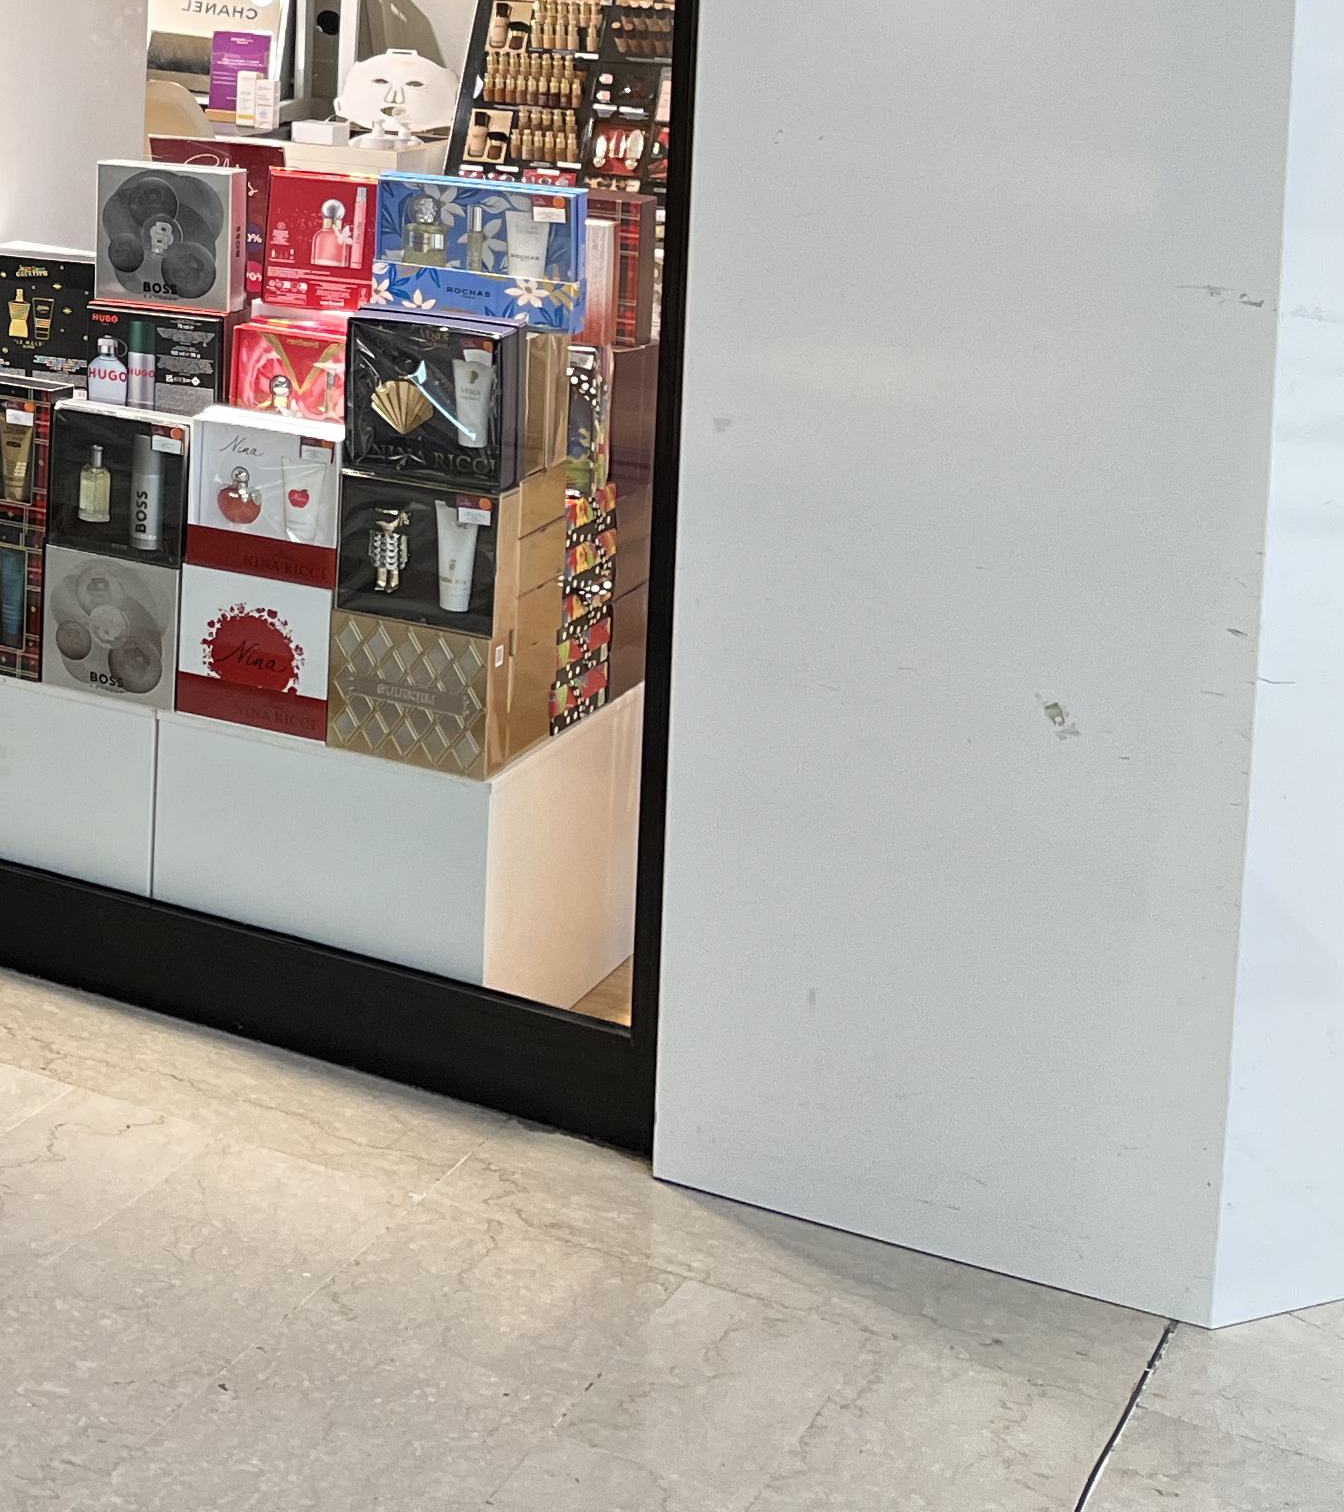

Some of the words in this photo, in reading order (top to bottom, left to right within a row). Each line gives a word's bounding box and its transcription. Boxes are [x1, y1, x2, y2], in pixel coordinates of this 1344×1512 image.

[142, 281, 178, 295] BOSS
[446, 286, 491, 298] ROCHAS
[92, 312, 119, 323] HUGO
[88, 367, 127, 382] HUGO
[127, 367, 156, 378] HUGO
[219, 435, 265, 457] Nina
[432, 451, 496, 474] RICCI
[135, 490, 148, 534] BOSS
[213, 639, 287, 673] Nina
[89, 671, 124, 688] BOSS
